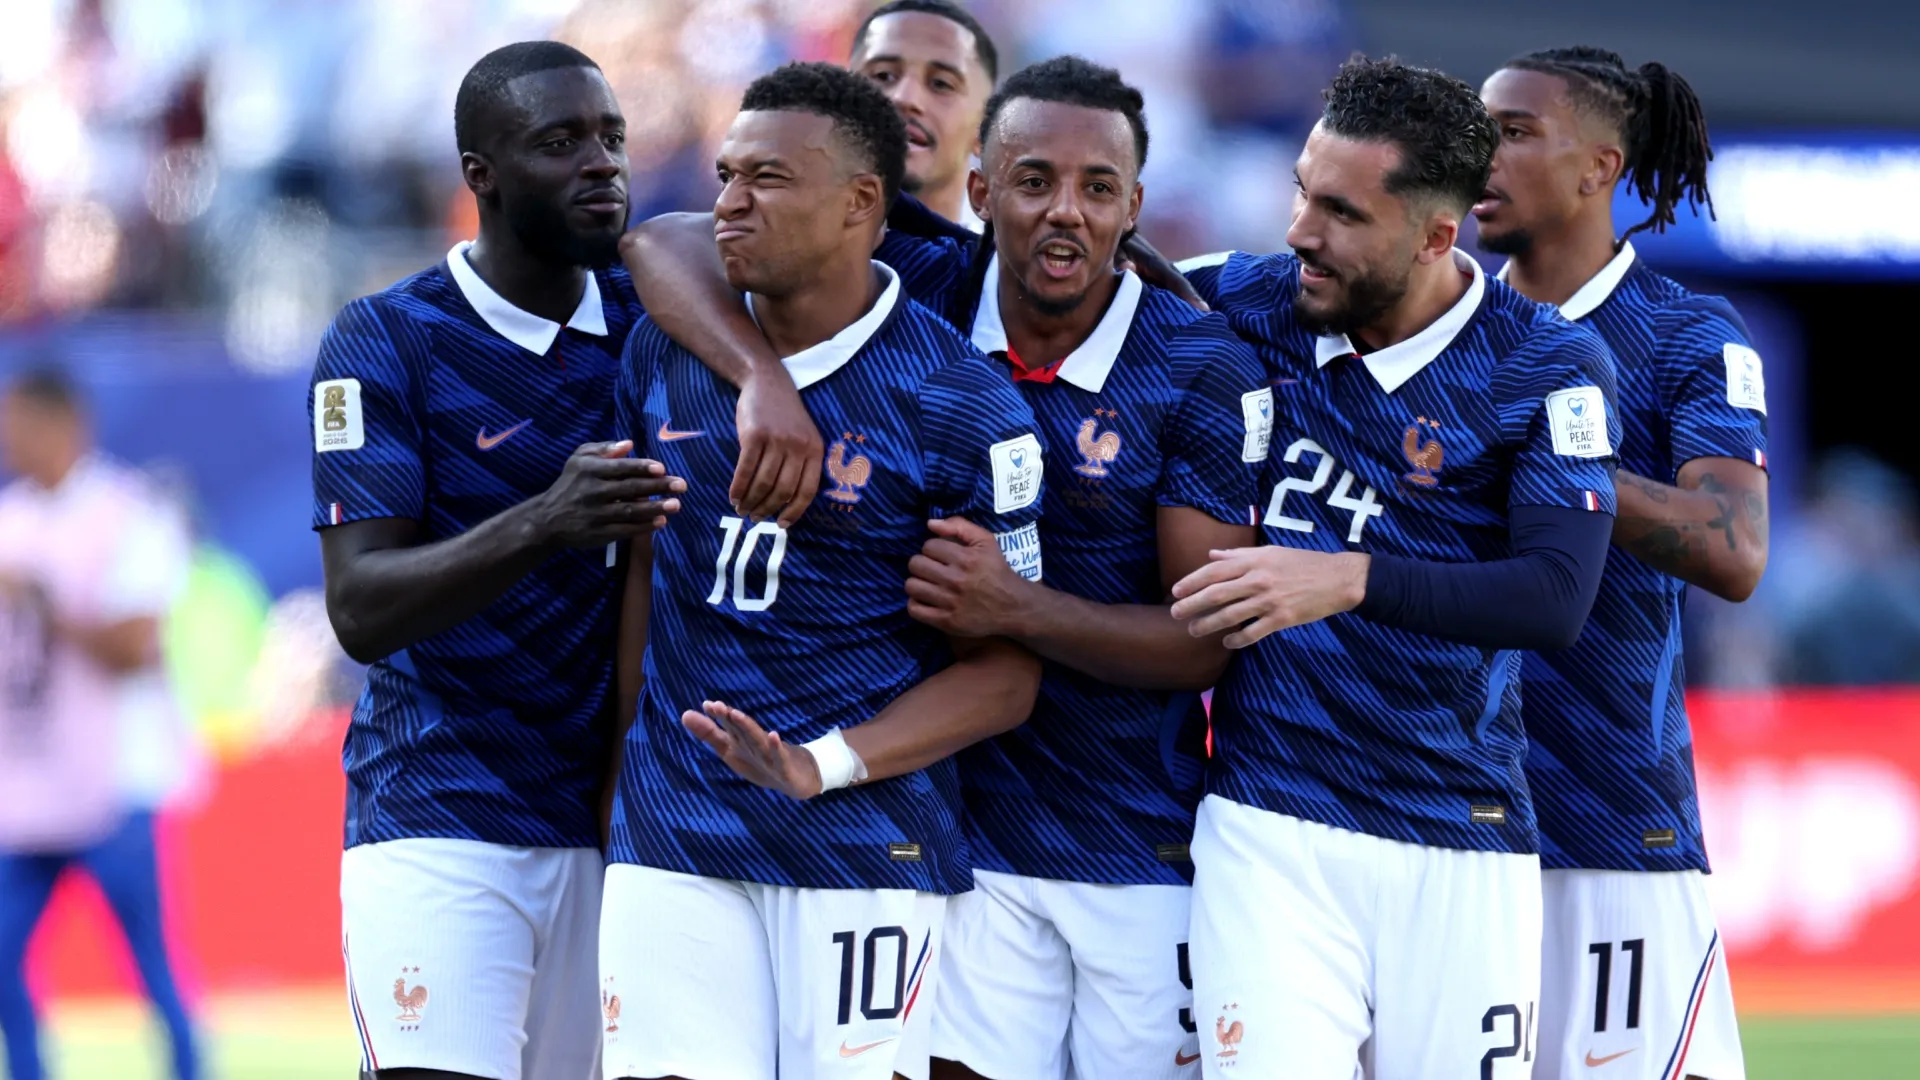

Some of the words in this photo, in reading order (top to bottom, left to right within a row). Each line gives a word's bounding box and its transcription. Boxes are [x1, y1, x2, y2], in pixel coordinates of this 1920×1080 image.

[323, 437, 348, 447] 2026
[1570, 430, 1595, 443] PEACE
[1009, 479, 1030, 495] PEACE
[1263, 438, 1384, 544] 24
[706, 516, 787, 611] 10
[997, 528, 1038, 552] UNITE
[832, 925, 908, 1025] 10
[1589, 938, 1644, 1033] 11
